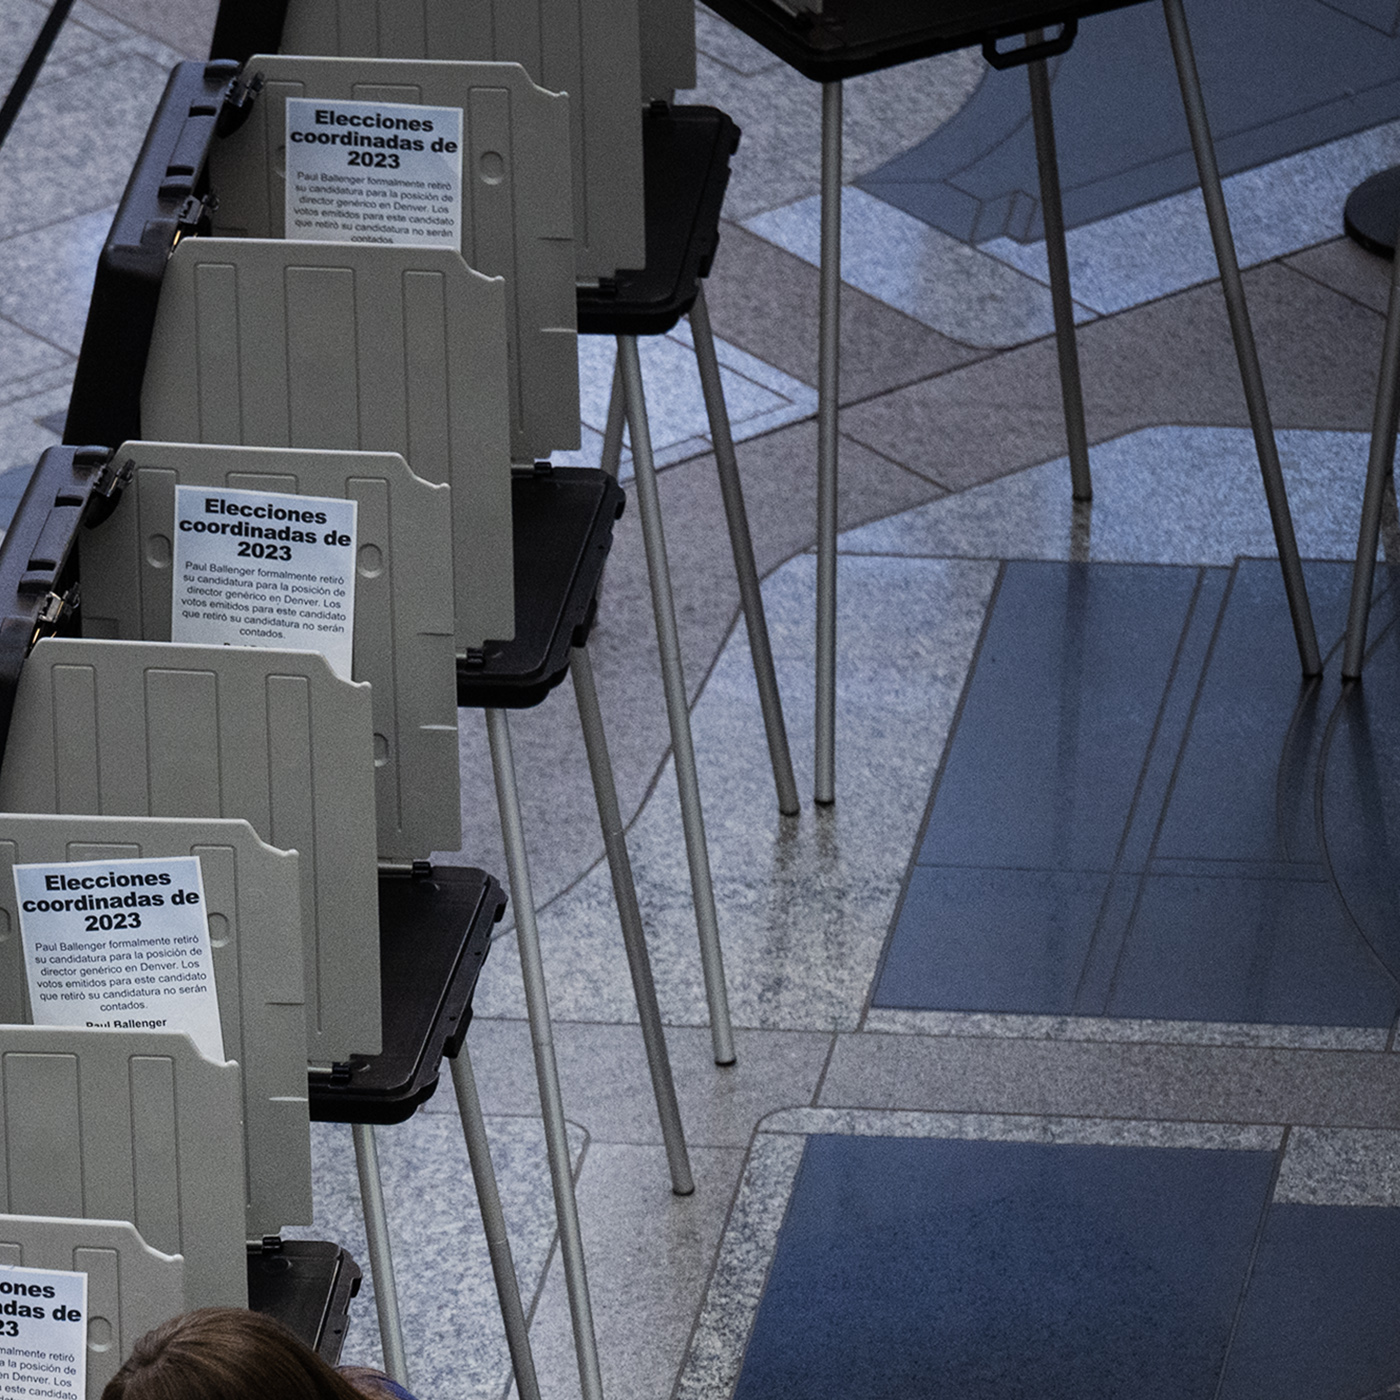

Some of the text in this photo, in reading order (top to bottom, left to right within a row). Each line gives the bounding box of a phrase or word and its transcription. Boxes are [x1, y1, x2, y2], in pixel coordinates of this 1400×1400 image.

[315, 110, 434, 132] Elecciones
[290, 131, 458, 153] coordinadas de
[347, 151, 400, 169] 2023
[297, 171, 452, 191] Paul Ballenger formalmente retiró
[309, 186, 364, 196] candidatura
[205, 498, 327, 524] Elecciones
[179, 520, 352, 547] coordinadas de
[237, 541, 292, 561] 2023
[185, 561, 345, 585] Paul Ballenger formalmente retiró
[183, 574, 346, 597] su candidatura para la posición de
[186, 586, 223, 597] director
[225, 591, 267, 601] genérico
[284, 595, 320, 606] Denver.
[323, 599, 341, 609] Los
[181, 598, 347, 621] votos emitidos para este candidato
[181, 610, 345, 633] que retiró su candidatura no serán
[239, 628, 286, 638] contados.
[45, 872, 171, 891] Elecciones
[22, 889, 200, 912] coordinadas de
[84, 912, 142, 931] 2023
[35, 935, 199, 952] Paul Ballenger formalmente retiró
[49, 955, 107, 964] candidatura
[109, 953, 132, 963] para
[134, 951, 144, 959] la
[146, 948, 187, 960] posición
[189, 947, 202, 956] de
[40, 960, 200, 977] director genérico en Denver. Los
[36, 972, 207, 988] votos emitidos para este candidato
[39, 993, 58, 1002] que
[60, 992, 86, 1000] retiró
[102, 988, 161, 999] candidatura
[179, 984, 207, 994] serán
[100, 1001, 148, 1012] contados.
[114, 1019, 167, 1029] Ballenger
[52, 1305, 82, 1322] de
[8, 1359, 17, 1368] la
[19, 1362, 61, 1373] posición
[63, 1366, 77, 1375] de
[49, 1353, 75, 1363] retiró
[12, 1372, 50, 1384] Denver.
[53, 1377, 72, 1387] Los
[4, 1385, 26, 1394] este
[28, 1388, 78, 1400] candidato
